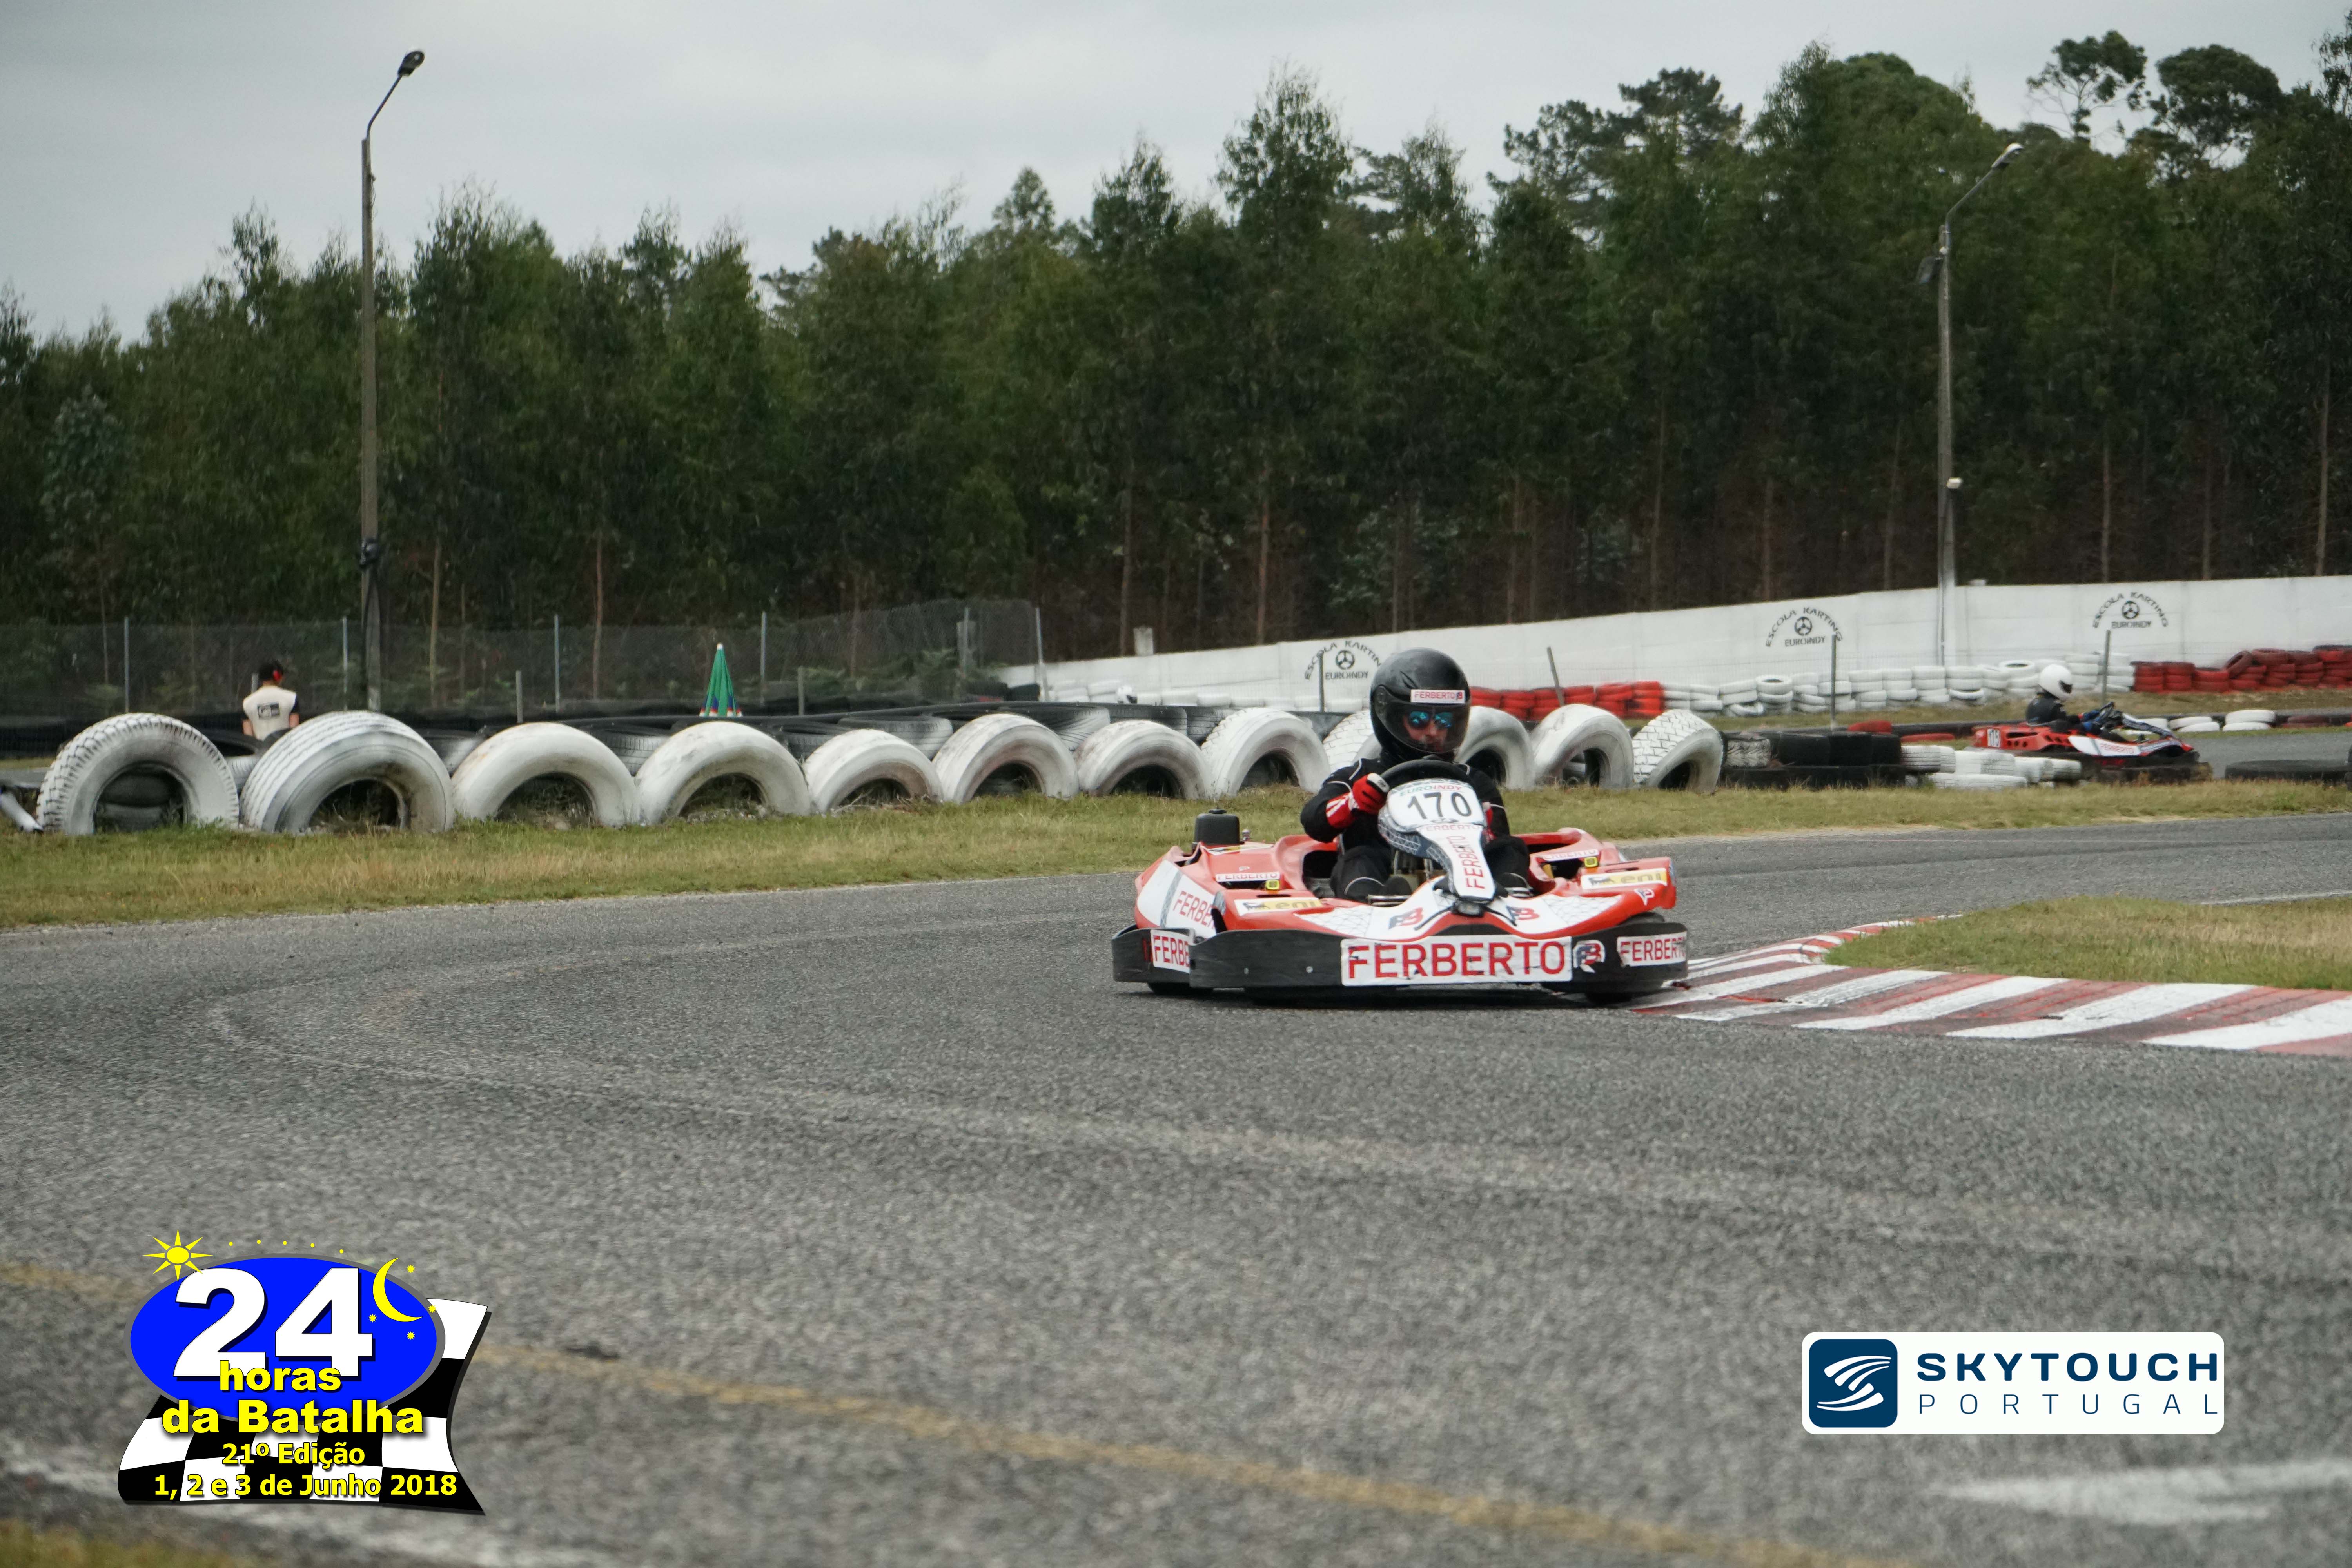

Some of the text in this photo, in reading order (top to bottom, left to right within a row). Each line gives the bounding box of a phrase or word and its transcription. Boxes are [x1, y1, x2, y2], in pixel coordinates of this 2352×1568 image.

[1766, 610, 1797, 647] ESCOLA
[1785, 636, 1825, 647] EUROINDY
[1325, 671, 1369, 680] EUROINDY
[1400, 785, 1462, 797] EUROINDY
[1408, 792, 1472, 819] 170
[1446, 835, 1485, 889] FERBERTO
[1621, 873, 1661, 884] eni
[1276, 901, 1316, 909] eni
[1348, 941, 1565, 978] FERBERTO
